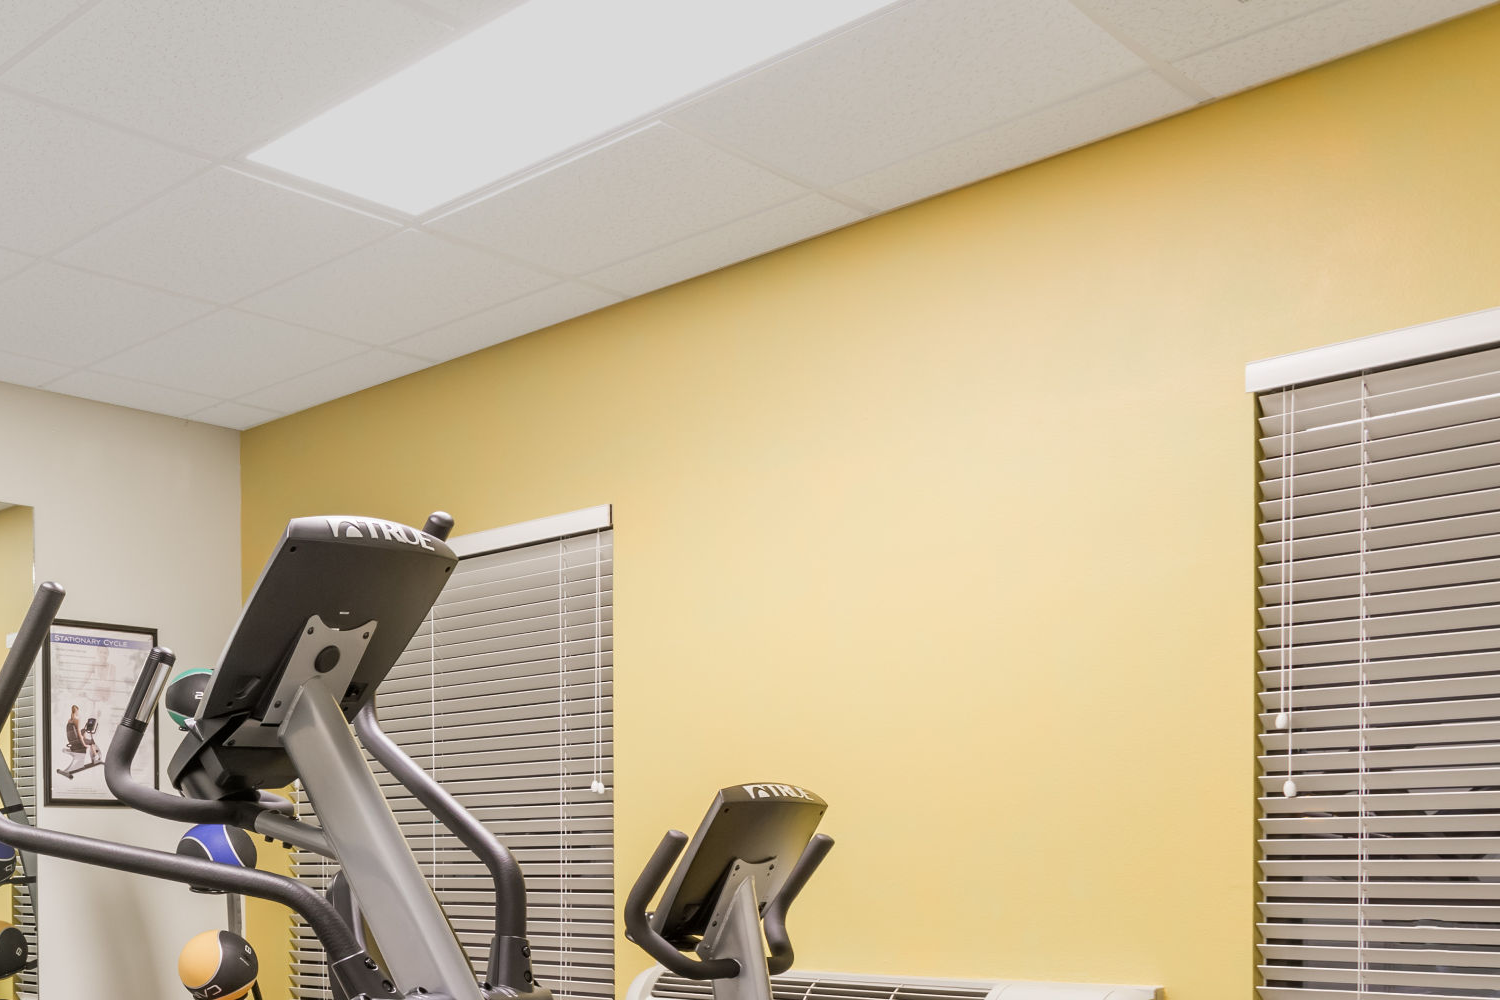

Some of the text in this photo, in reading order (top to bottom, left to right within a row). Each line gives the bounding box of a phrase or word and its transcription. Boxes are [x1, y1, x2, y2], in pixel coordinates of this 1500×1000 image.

[357, 519, 435, 551] TRUE
[54, 634, 128, 648] STATIONARY CYCLE
